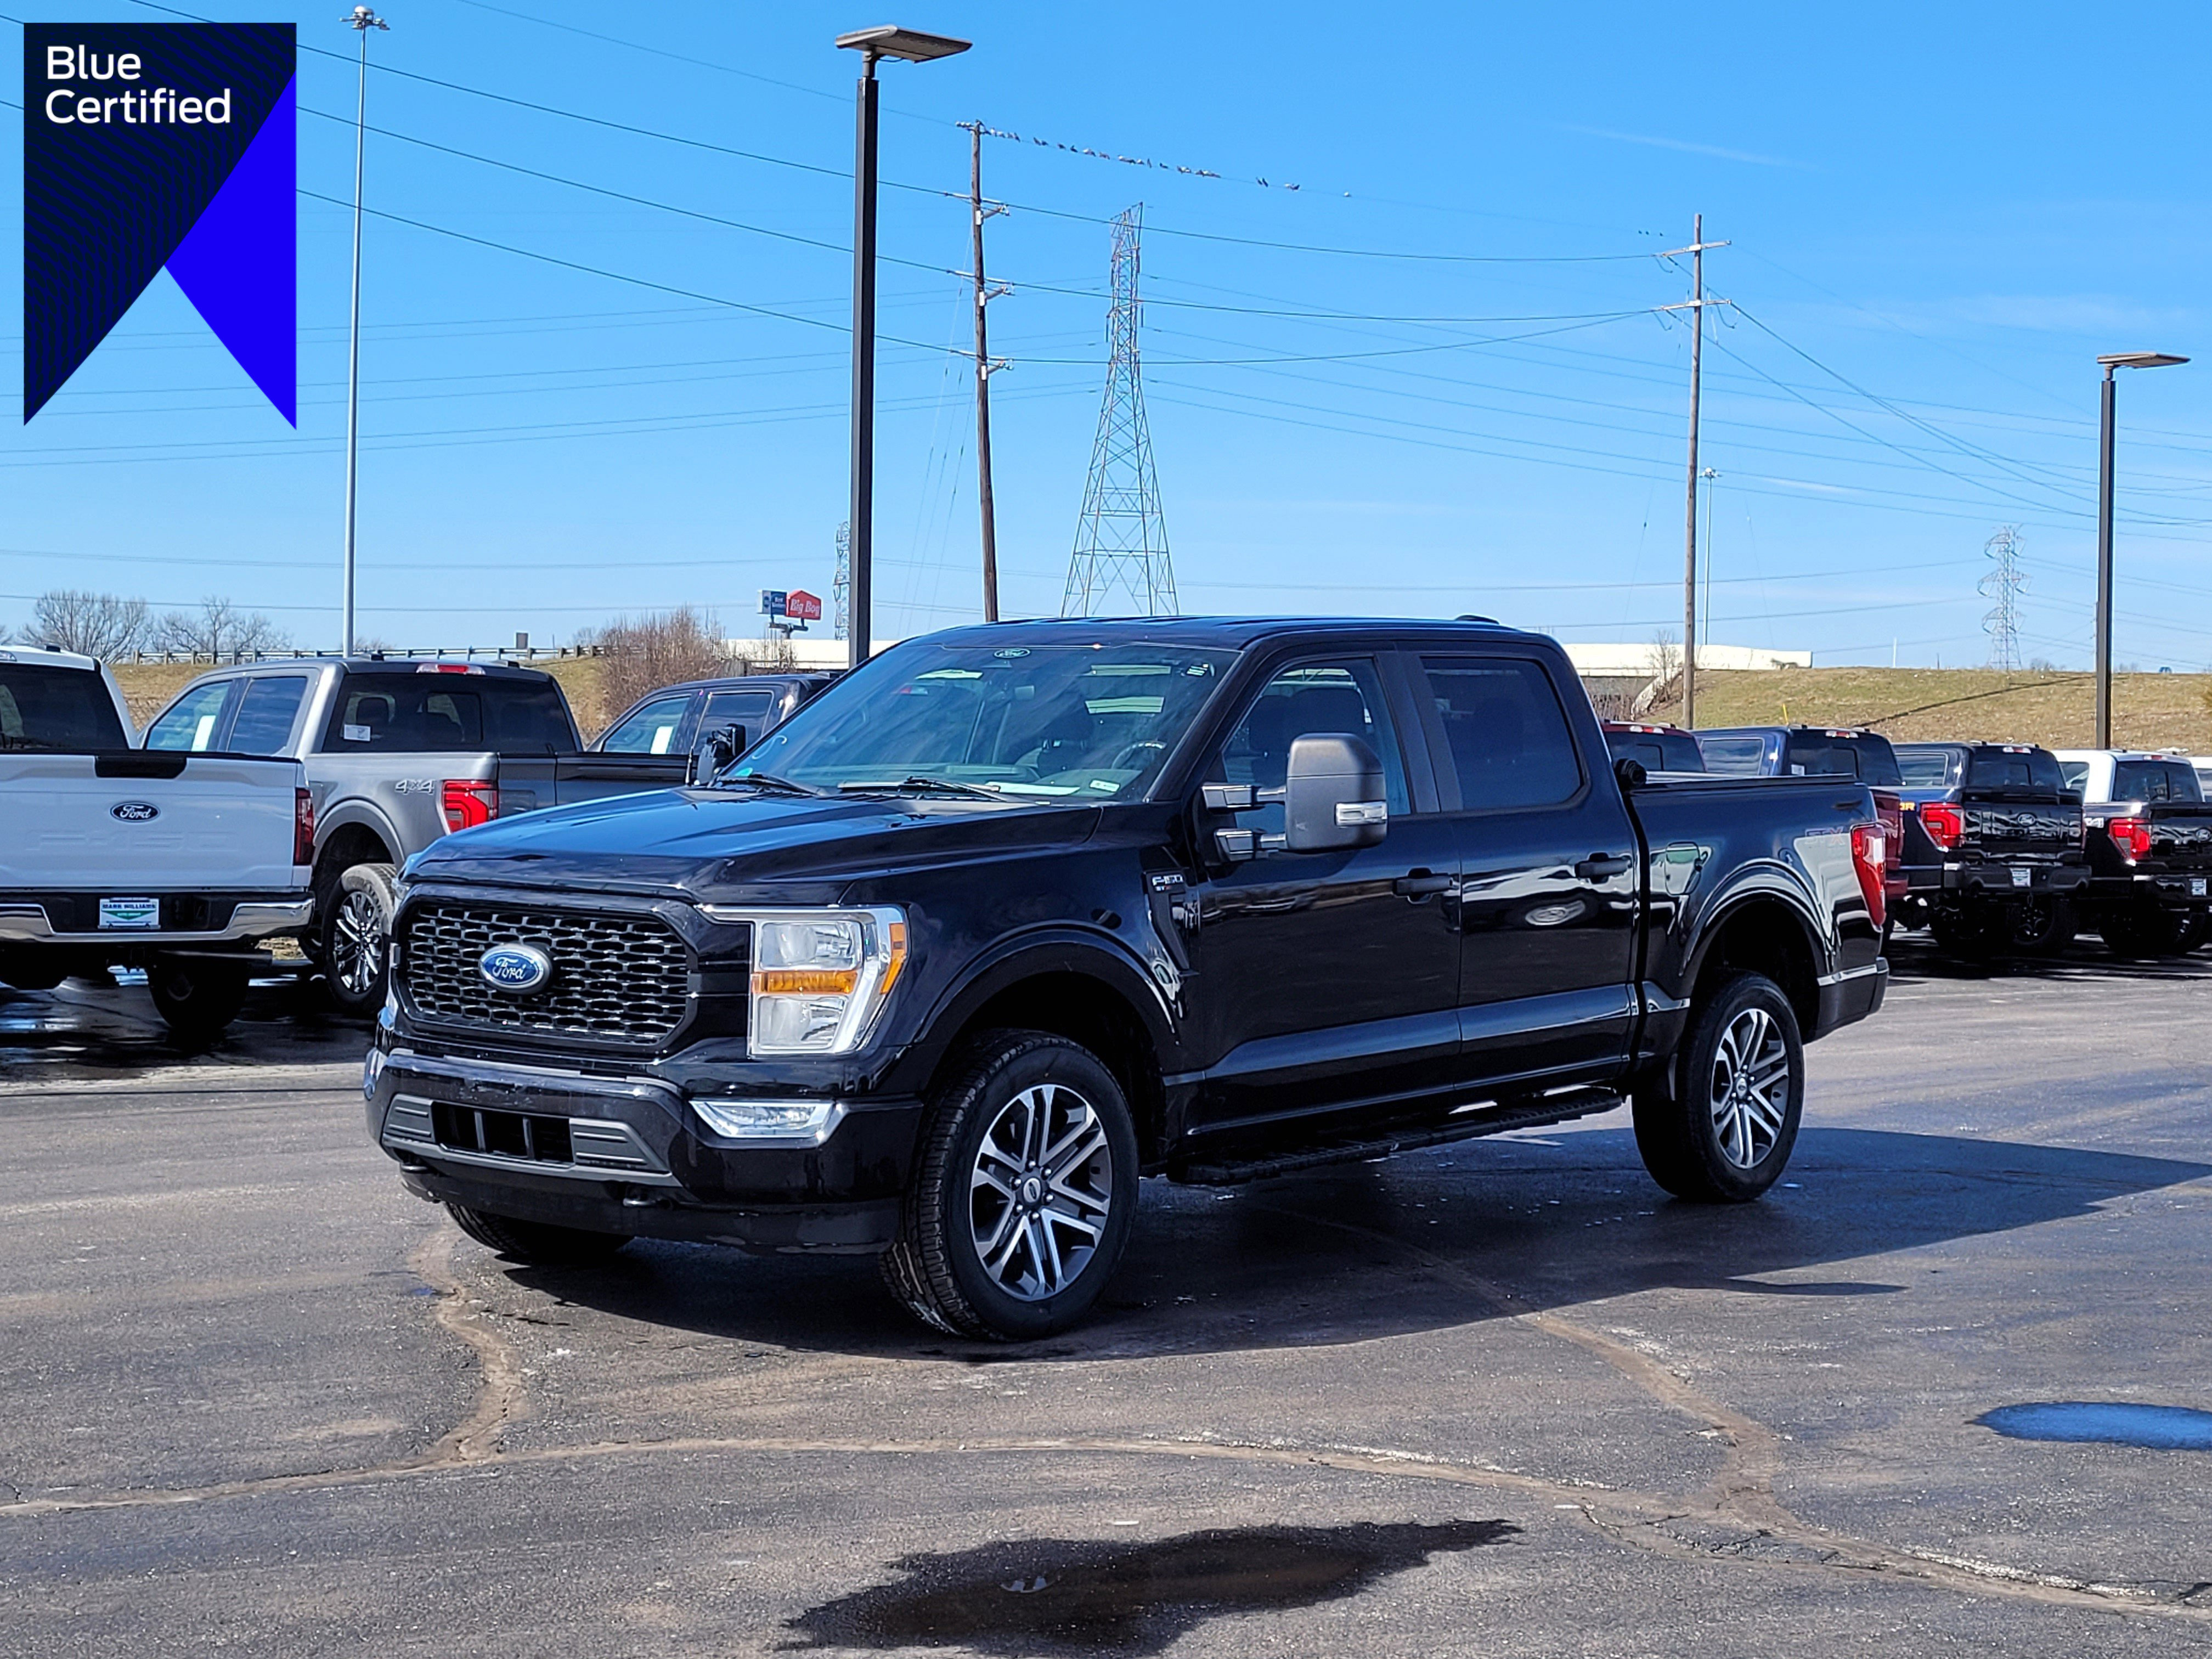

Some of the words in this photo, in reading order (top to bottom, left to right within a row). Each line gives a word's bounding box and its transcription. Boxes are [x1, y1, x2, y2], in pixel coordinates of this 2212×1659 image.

[790, 599, 804, 614] Big
[805, 601, 821, 617] Boy
[120, 805, 151, 820] Ford
[492, 956, 527, 980] Ford
